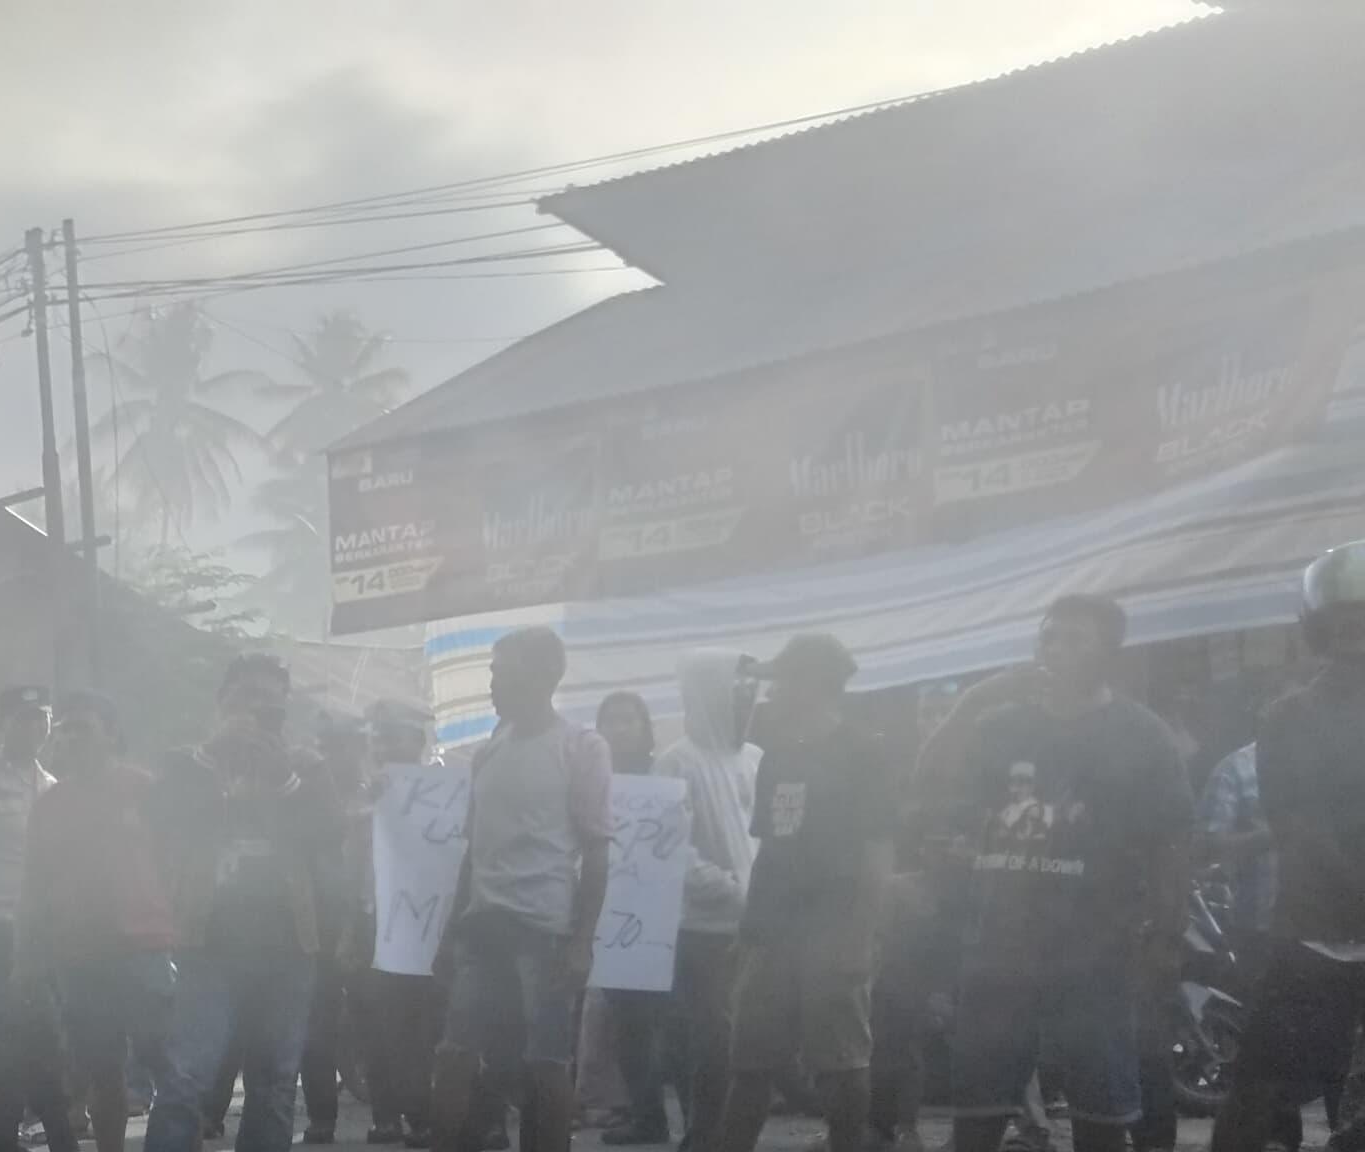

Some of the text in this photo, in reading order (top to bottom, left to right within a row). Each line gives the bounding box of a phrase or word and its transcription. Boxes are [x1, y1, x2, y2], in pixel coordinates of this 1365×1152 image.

[940, 399, 1091, 443] MANTAP
[357, 468, 414, 493] BARU
[605, 463, 735, 504] MANTAP
[334, 519, 436, 553] MANTAP
[351, 572, 385, 596] 14
